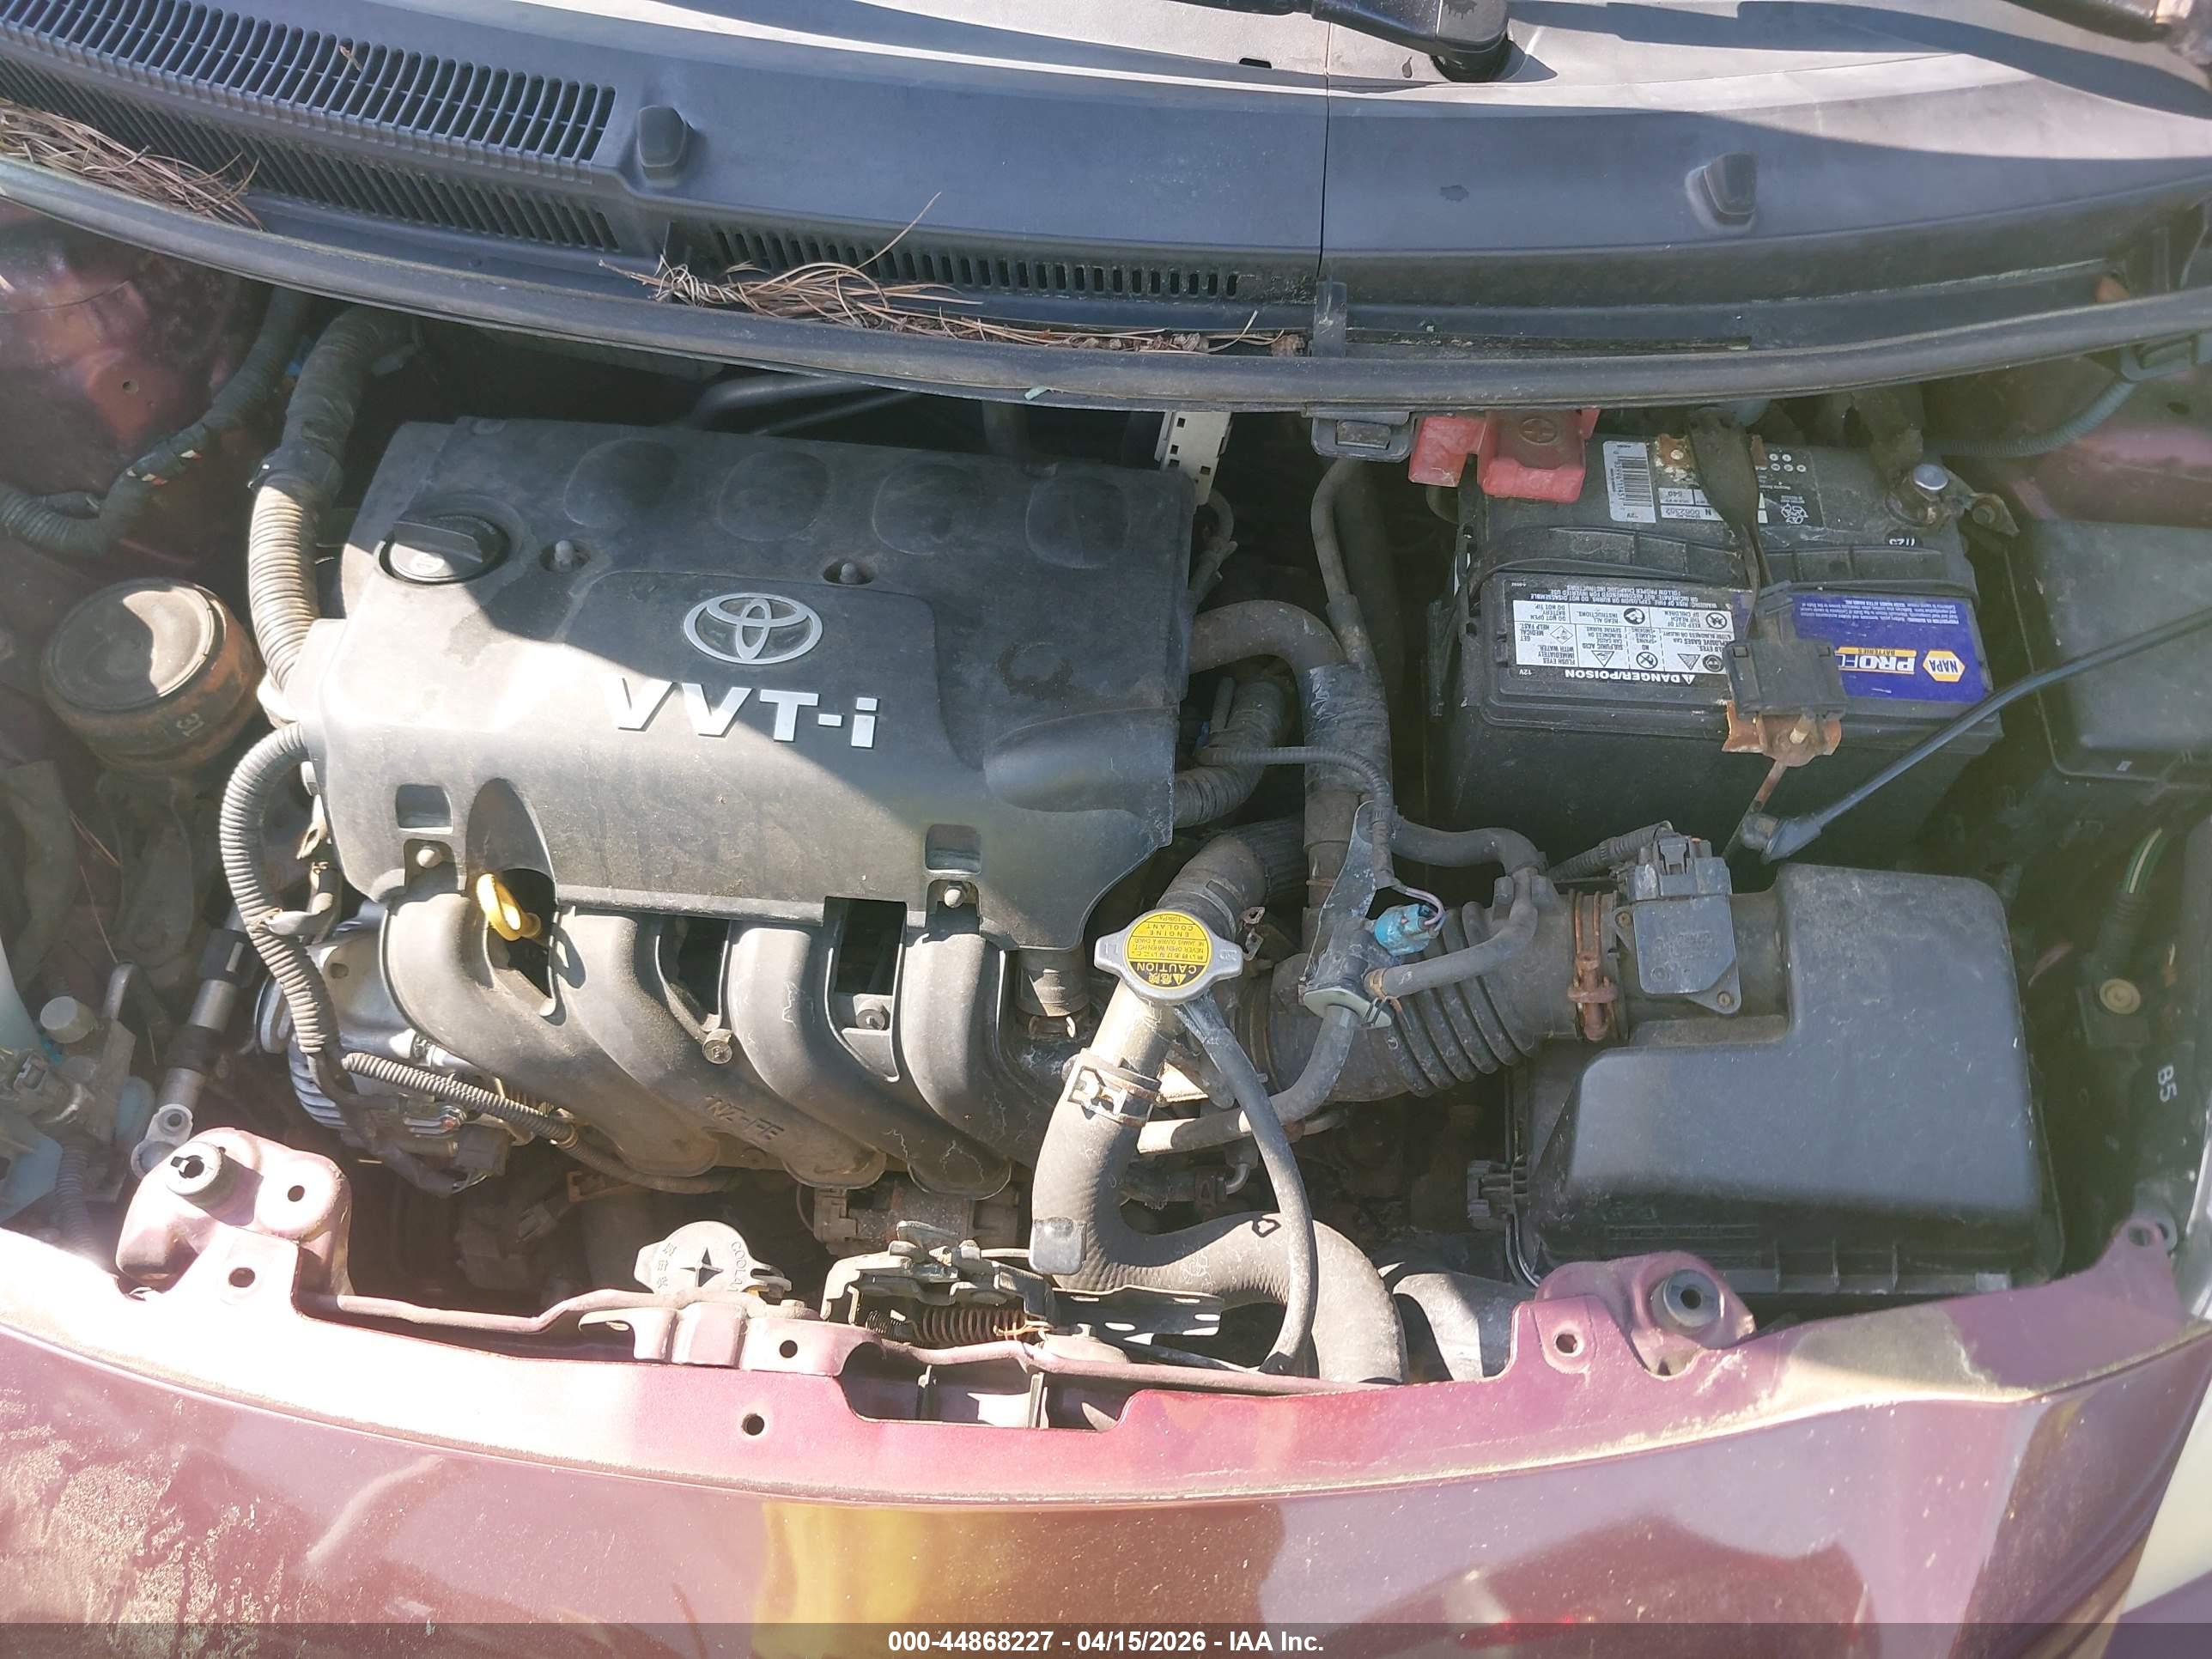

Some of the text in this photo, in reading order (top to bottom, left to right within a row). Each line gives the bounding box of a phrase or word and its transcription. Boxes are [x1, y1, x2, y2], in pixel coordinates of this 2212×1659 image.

[1928, 659, 1959, 674] NAPA
[1565, 669, 1681, 684] DANGER/POISON
[605, 678, 878, 748] VVT-i
[1136, 962, 1197, 975] CAUTION
[2157, 1064, 2178, 1103] B5
